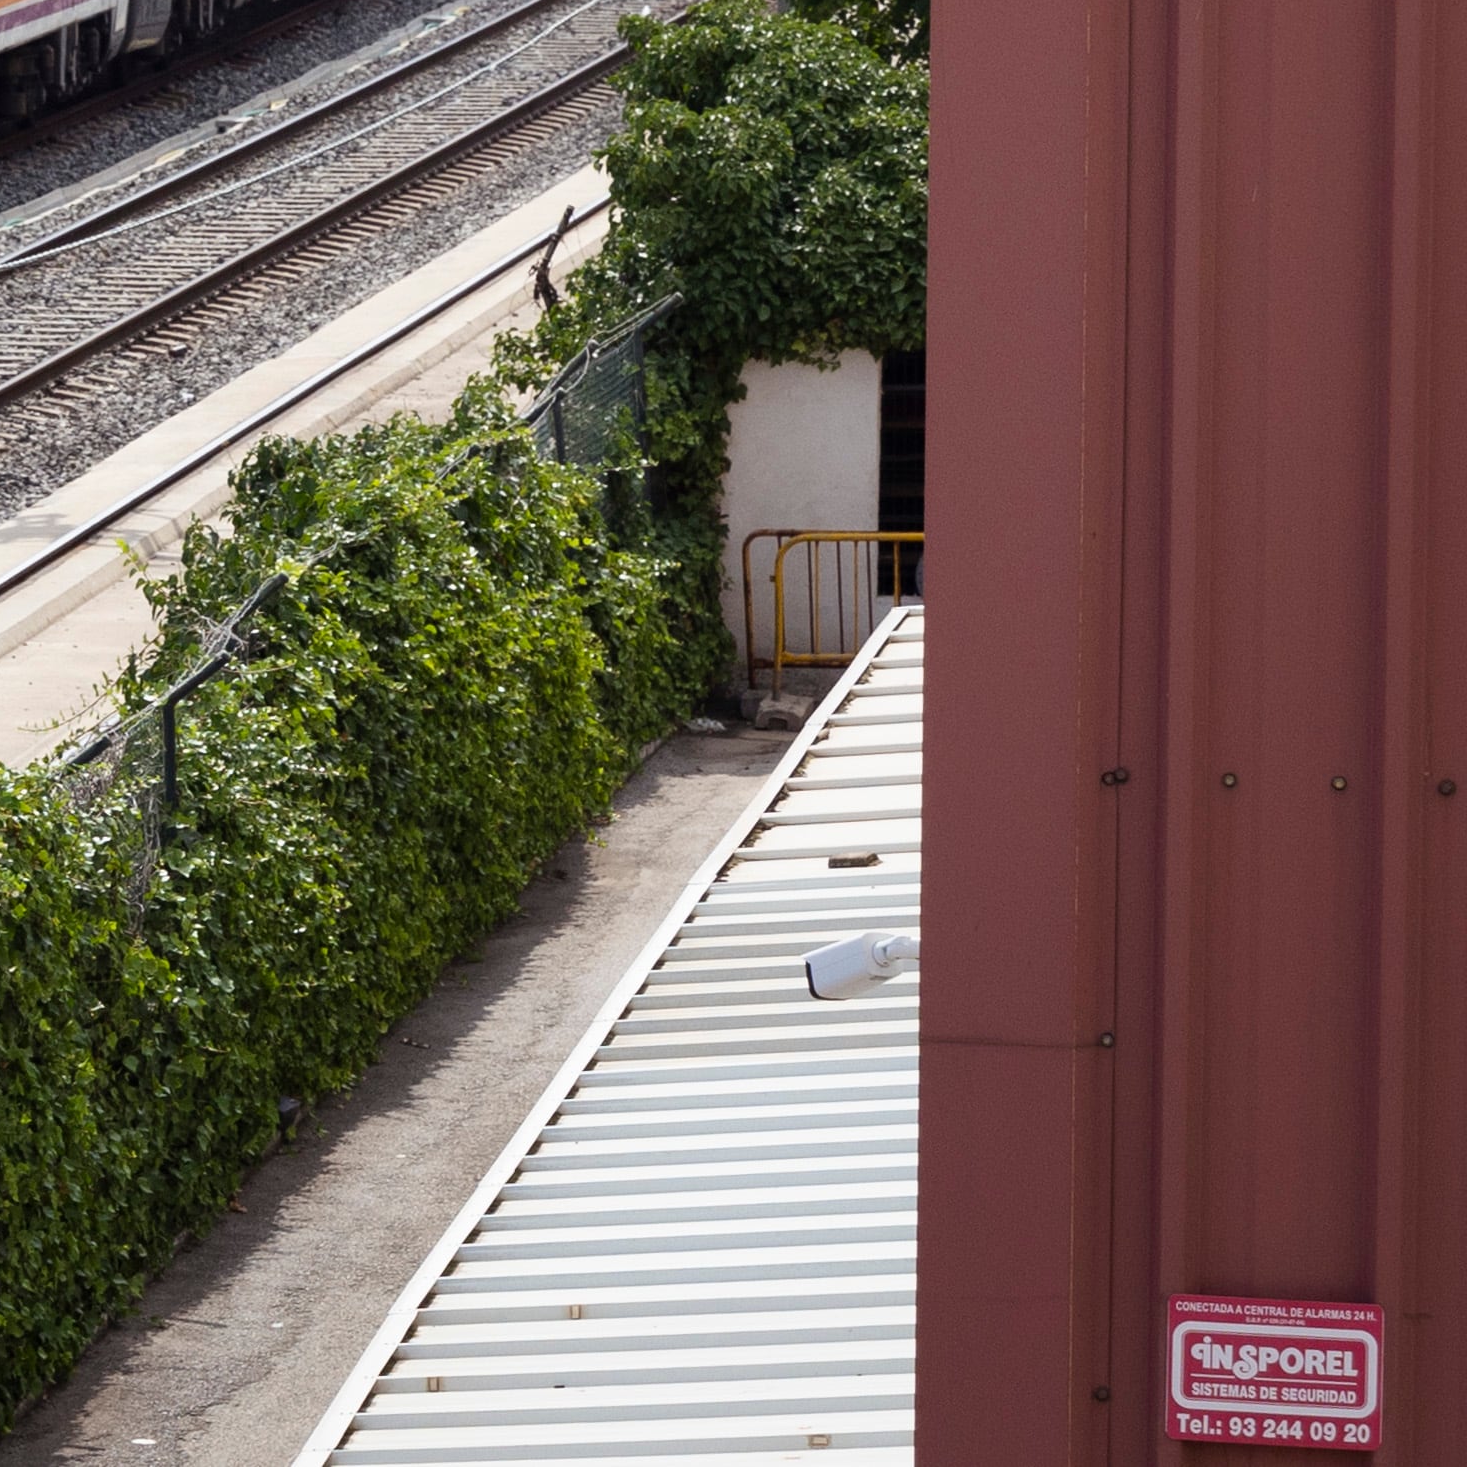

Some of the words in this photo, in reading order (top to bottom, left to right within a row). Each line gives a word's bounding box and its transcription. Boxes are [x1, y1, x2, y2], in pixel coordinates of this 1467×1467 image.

[1175, 1300, 1234, 1314] CONECTADA
[1235, 1304, 1243, 1315] A
[1243, 1304, 1288, 1318] CENTRAL
[1290, 1307, 1304, 1319] DE
[1305, 1308, 1352, 1321] ALARMAS
[1353, 1311, 1365, 1322] 24
[1366, 1311, 1378, 1323] H.
[1191, 1382, 1257, 1400] SISTEMAS
[1259, 1387, 1277, 1400] DE
[1281, 1388, 1357, 1405] SEGURIDAD
[1176, 1413, 1223, 1435] Tel.:
[1228, 1416, 1257, 1438] 93
[1262, 1418, 1304, 1441] 244
[1309, 1421, 1337, 1442] 09
[1343, 1423, 1371, 1444] 20
